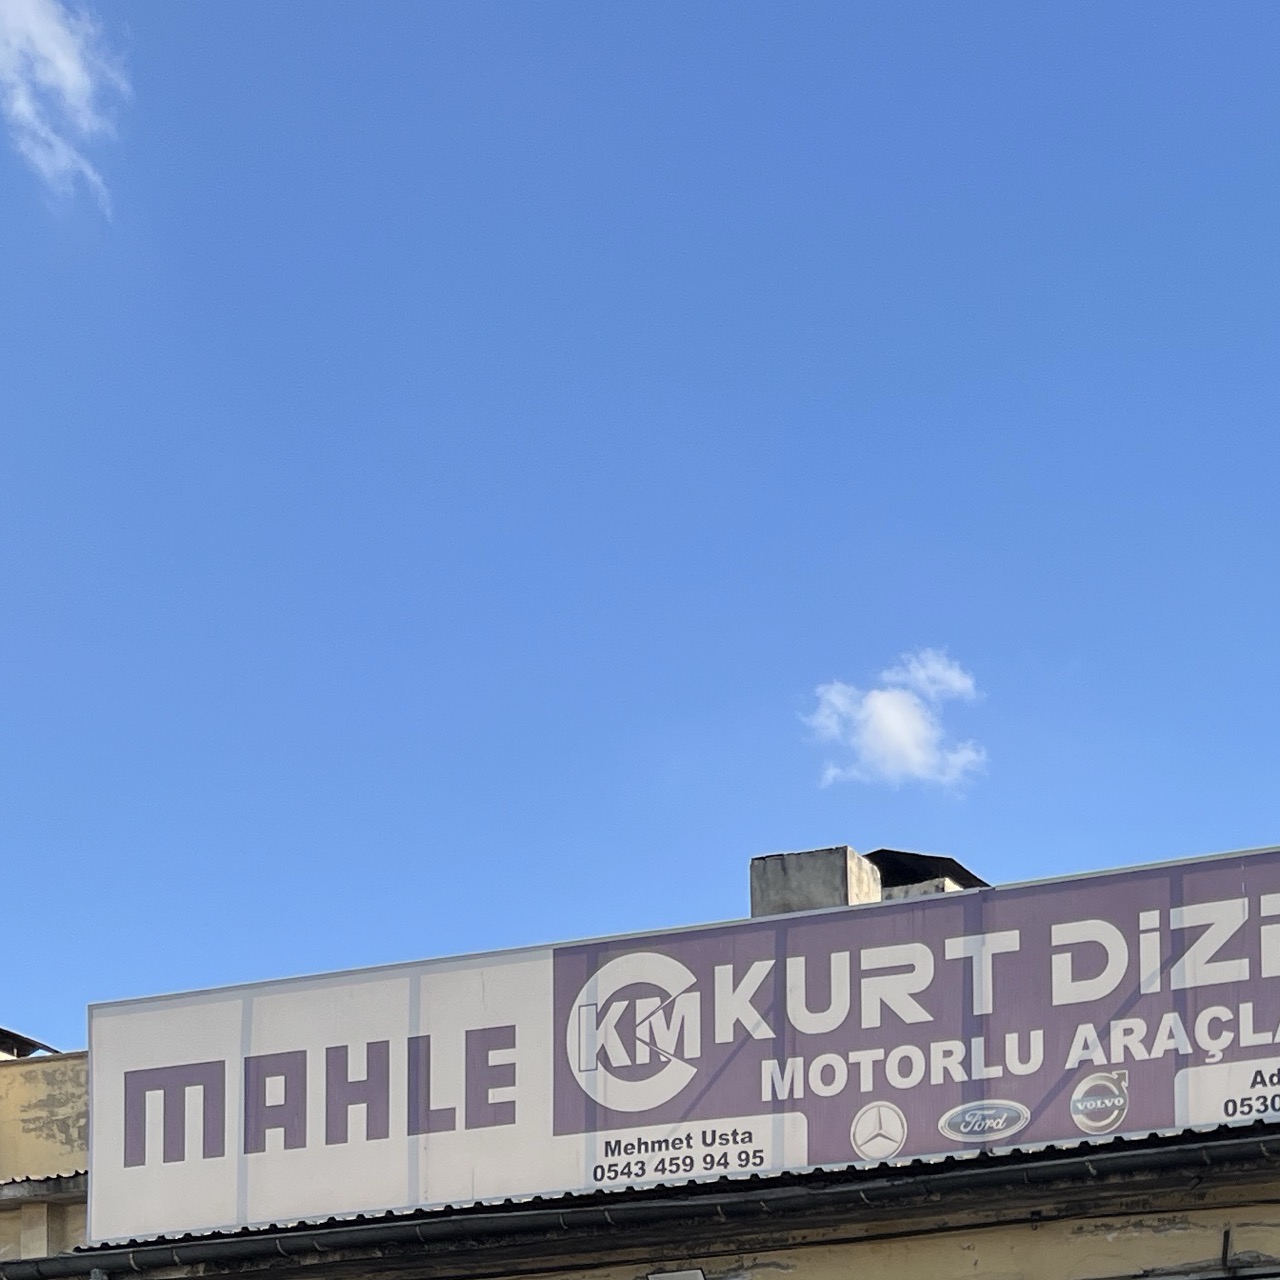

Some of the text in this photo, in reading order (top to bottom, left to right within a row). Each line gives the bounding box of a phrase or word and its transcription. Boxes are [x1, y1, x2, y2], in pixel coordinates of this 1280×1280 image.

[714, 930, 1020, 1044] KURT
[761, 1030, 1044, 1101] MOTORLU
[124, 1025, 516, 1168] MAHLE
[1076, 1097, 1124, 1111] VOLVO
[960, 1109, 1007, 1133] Ford
[604, 1128, 753, 1158] Mehmet Usta
[593, 1149, 765, 1182] 0543 459 94 95
